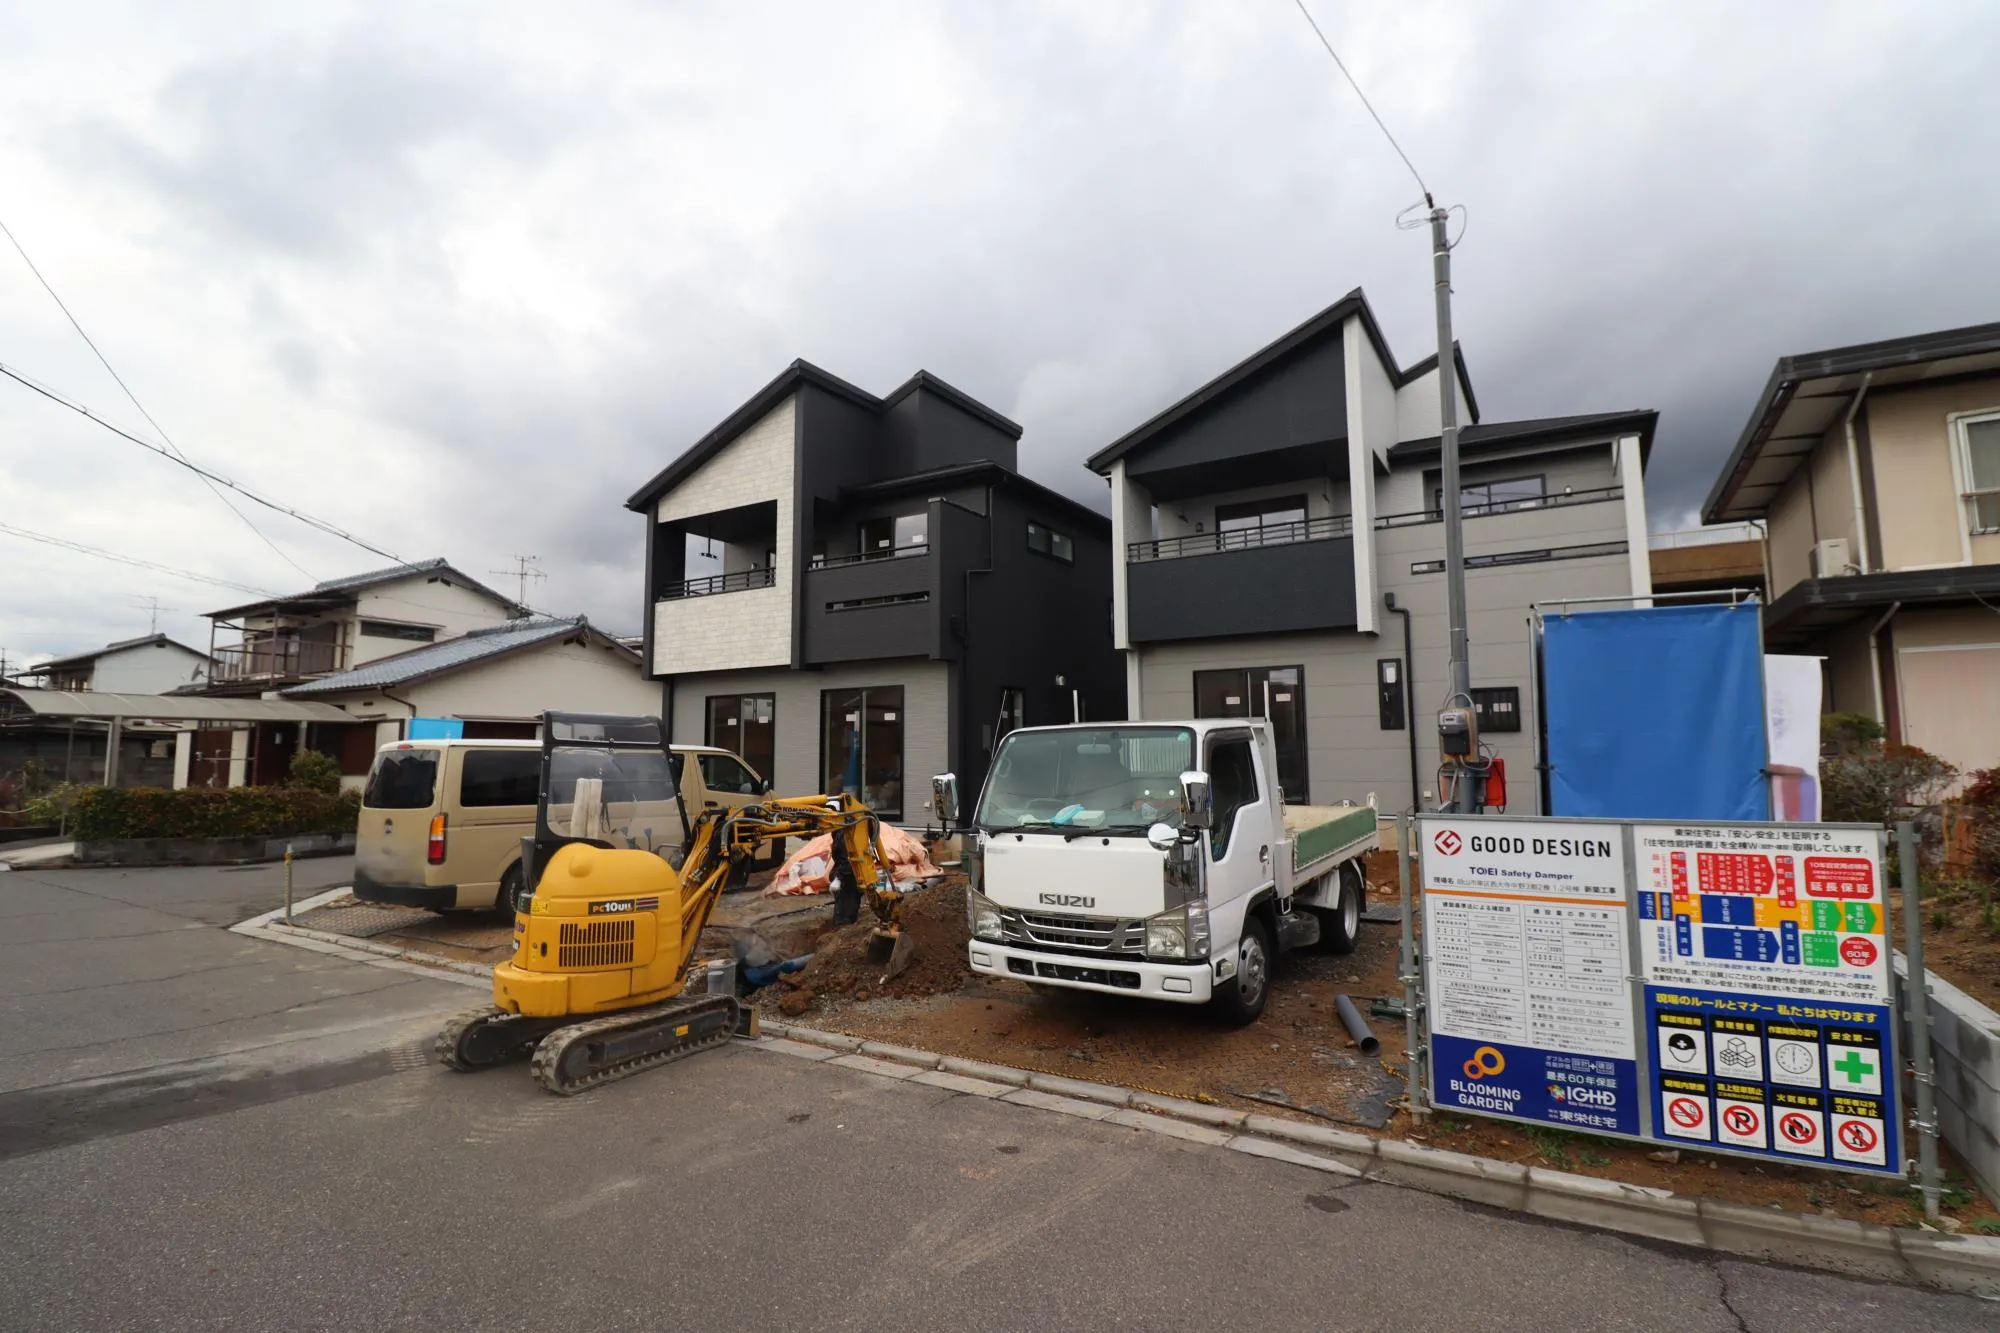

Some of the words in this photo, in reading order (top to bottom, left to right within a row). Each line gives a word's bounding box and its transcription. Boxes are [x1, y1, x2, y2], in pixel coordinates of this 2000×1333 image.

[1471, 836, 1525, 854] GOOD
[1533, 839, 1611, 858] DESIGN
[1501, 869, 1532, 879] Safety
[1535, 871, 1573, 880] Damper
[1039, 893, 1095, 908] ISUZU
[1656, 993, 1774, 1011] 現場のルールとマナー
[1777, 1004, 1877, 1023] 私たちは守ります
[1831, 1032, 1874, 1042] 安全第一
[1547, 1071, 1617, 1088] 最長60年保証
[1450, 1079, 1521, 1101] BLOOMING
[1458, 1093, 1514, 1113] GARDEN
[1776, 1094, 1817, 1105] 火気厳禁
[1560, 1110, 1617, 1128] 東栄住宅
[1835, 1104, 1878, 1117] 立入禁止
